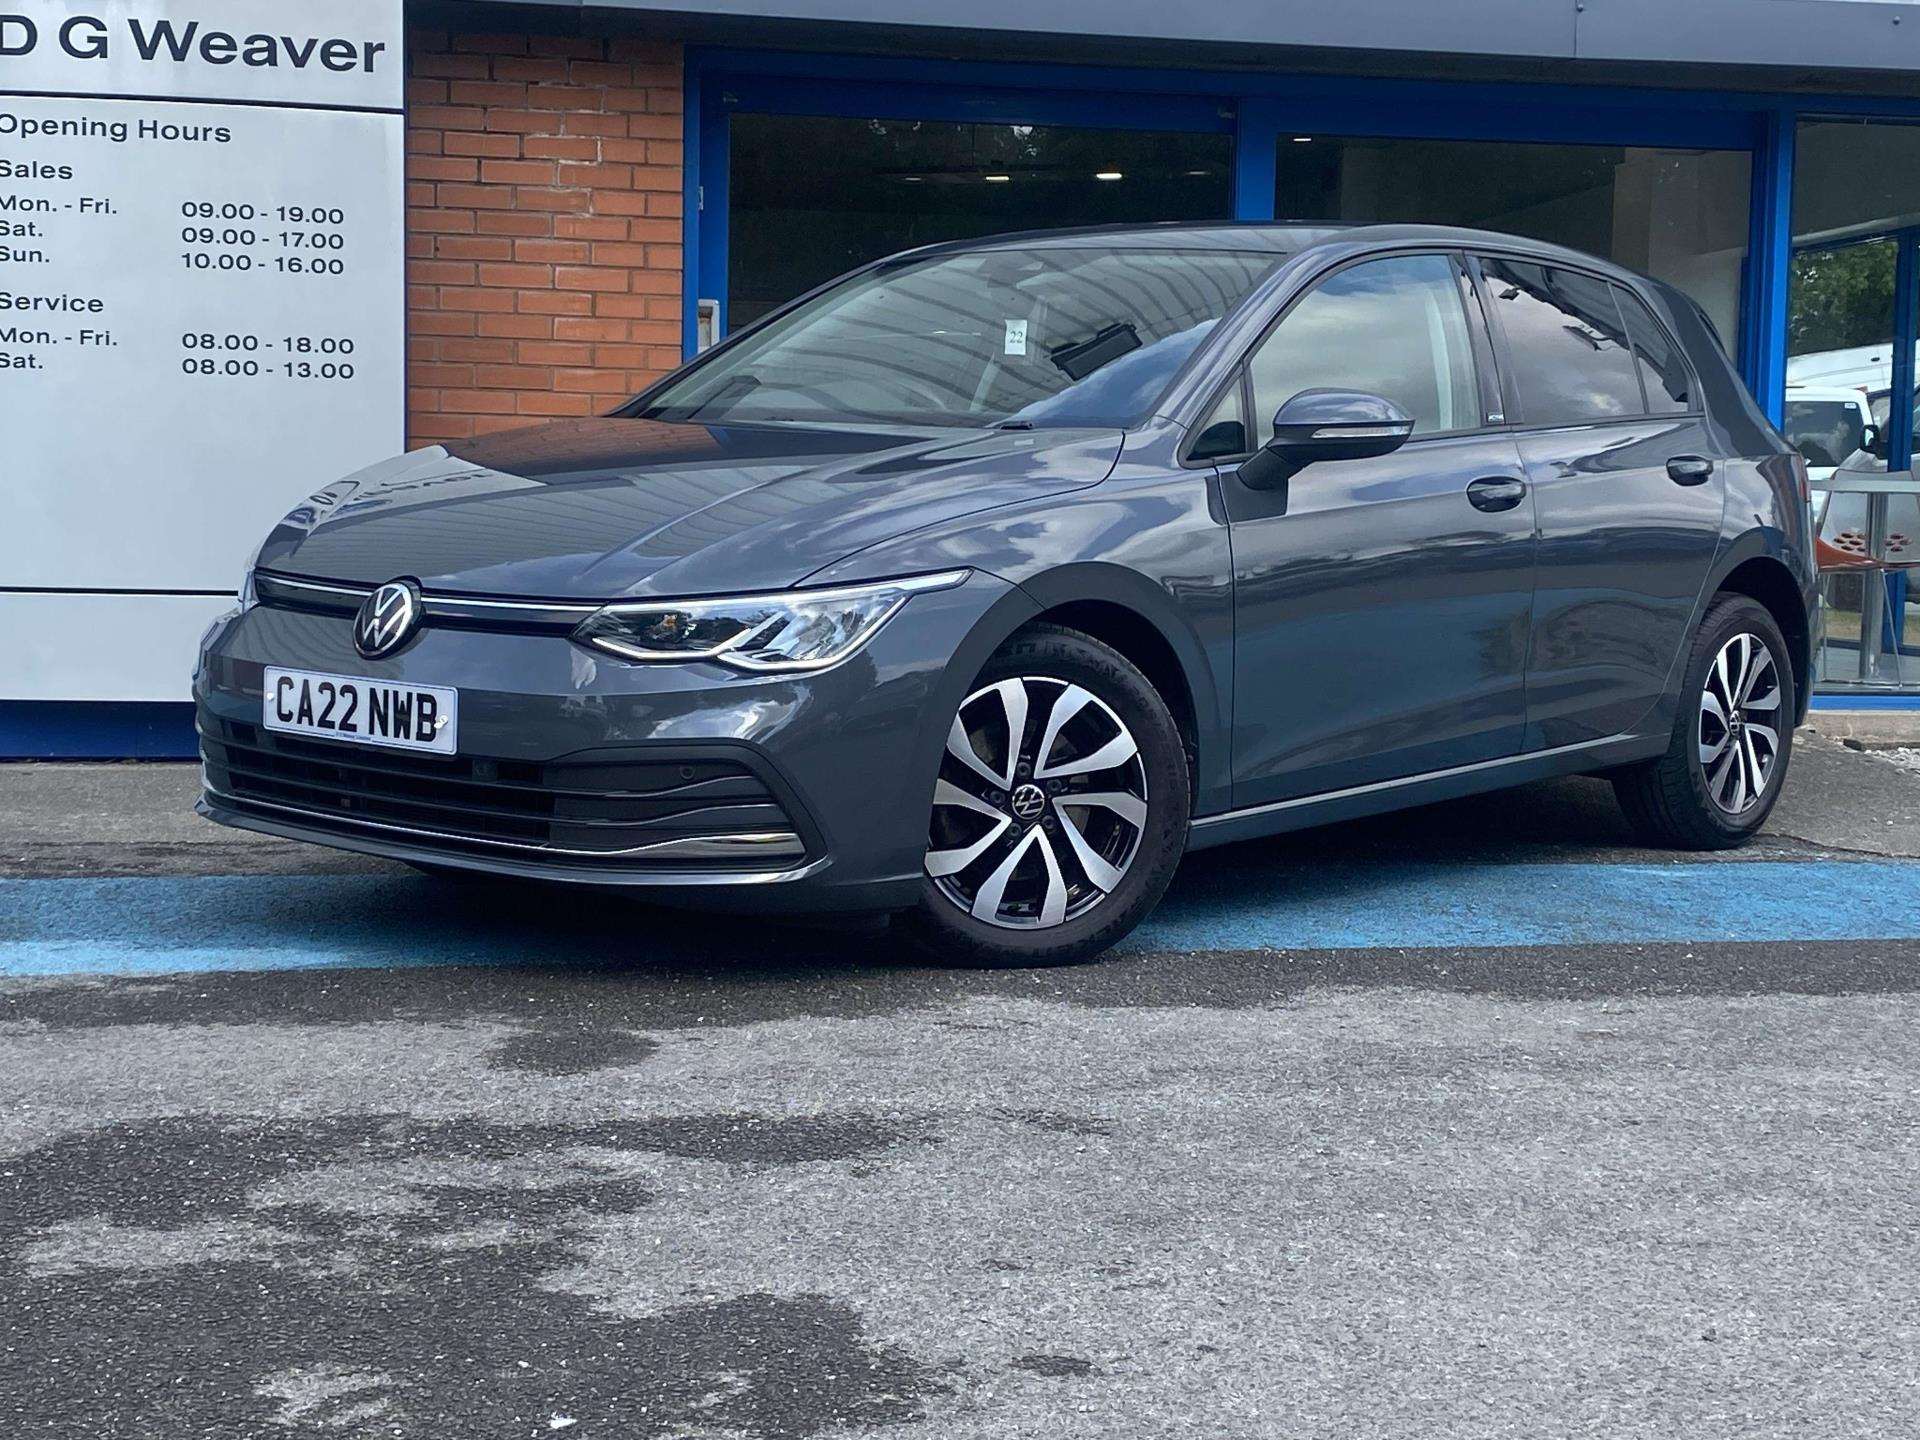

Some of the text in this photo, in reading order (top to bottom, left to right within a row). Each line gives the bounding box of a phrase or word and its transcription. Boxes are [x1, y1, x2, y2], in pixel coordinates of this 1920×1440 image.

[0, 15, 385, 73] D G Weaver
[0, 114, 231, 142] Opening Hours
[0, 160, 73, 180] Sales
[80, 198, 117, 215] Fri.
[182, 202, 254, 221] 09.00
[276, 206, 344, 225] 19.00
[0, 220, 43, 237] Sat.
[182, 227, 255, 246] 09.00
[279, 232, 343, 249] 17.00
[0, 246, 49, 263] Sun.
[182, 253, 251, 271] 10.00
[275, 257, 343, 274] 16.00
[0, 292, 103, 312] Service
[80, 330, 117, 346] Fri.
[182, 333, 258, 351] 08.00
[283, 337, 354, 354] 18.00
[0, 352, 43, 369] Sat.
[182, 358, 258, 377] 08.00
[284, 362, 354, 379] 13.00
[276, 676, 438, 742] CA22 NWB
